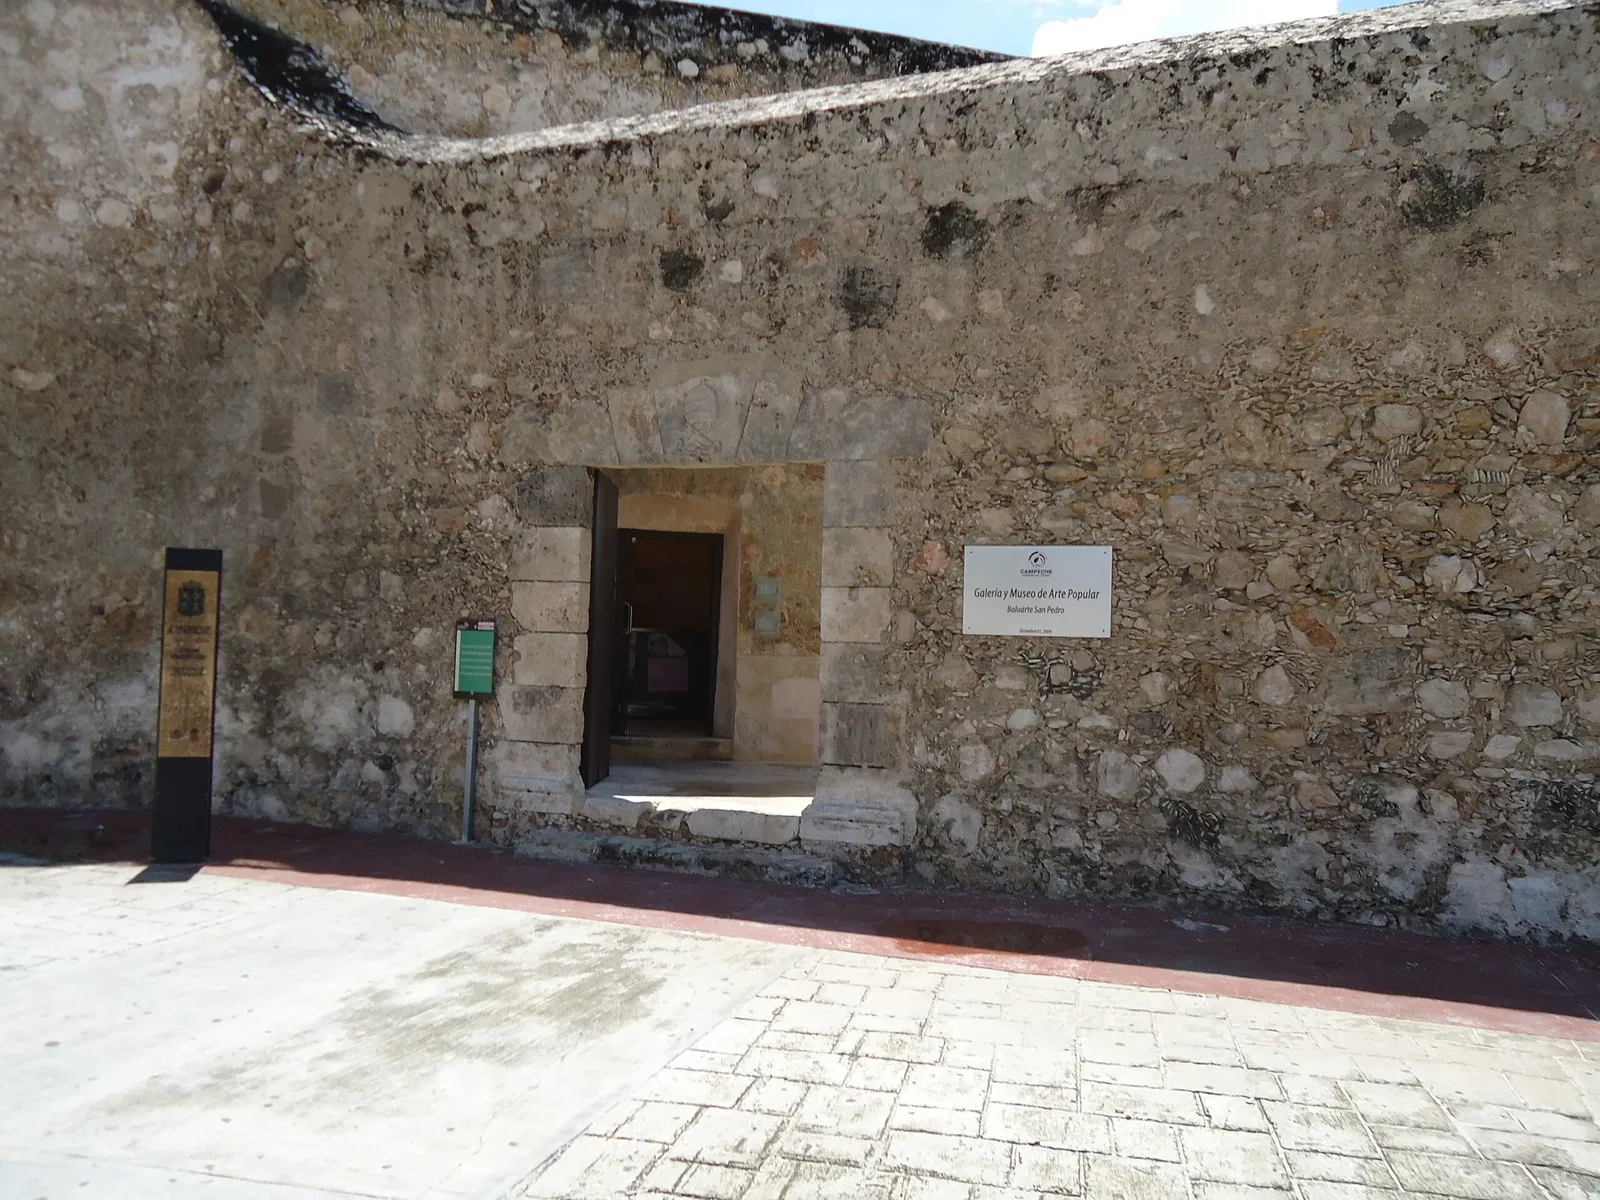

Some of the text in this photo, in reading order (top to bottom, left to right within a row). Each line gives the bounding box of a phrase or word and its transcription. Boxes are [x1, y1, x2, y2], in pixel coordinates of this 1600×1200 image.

[974, 588, 1100, 601] Galería y Museo de Arte Popular
[1007, 605, 1065, 615] Baluarte San Pedro
